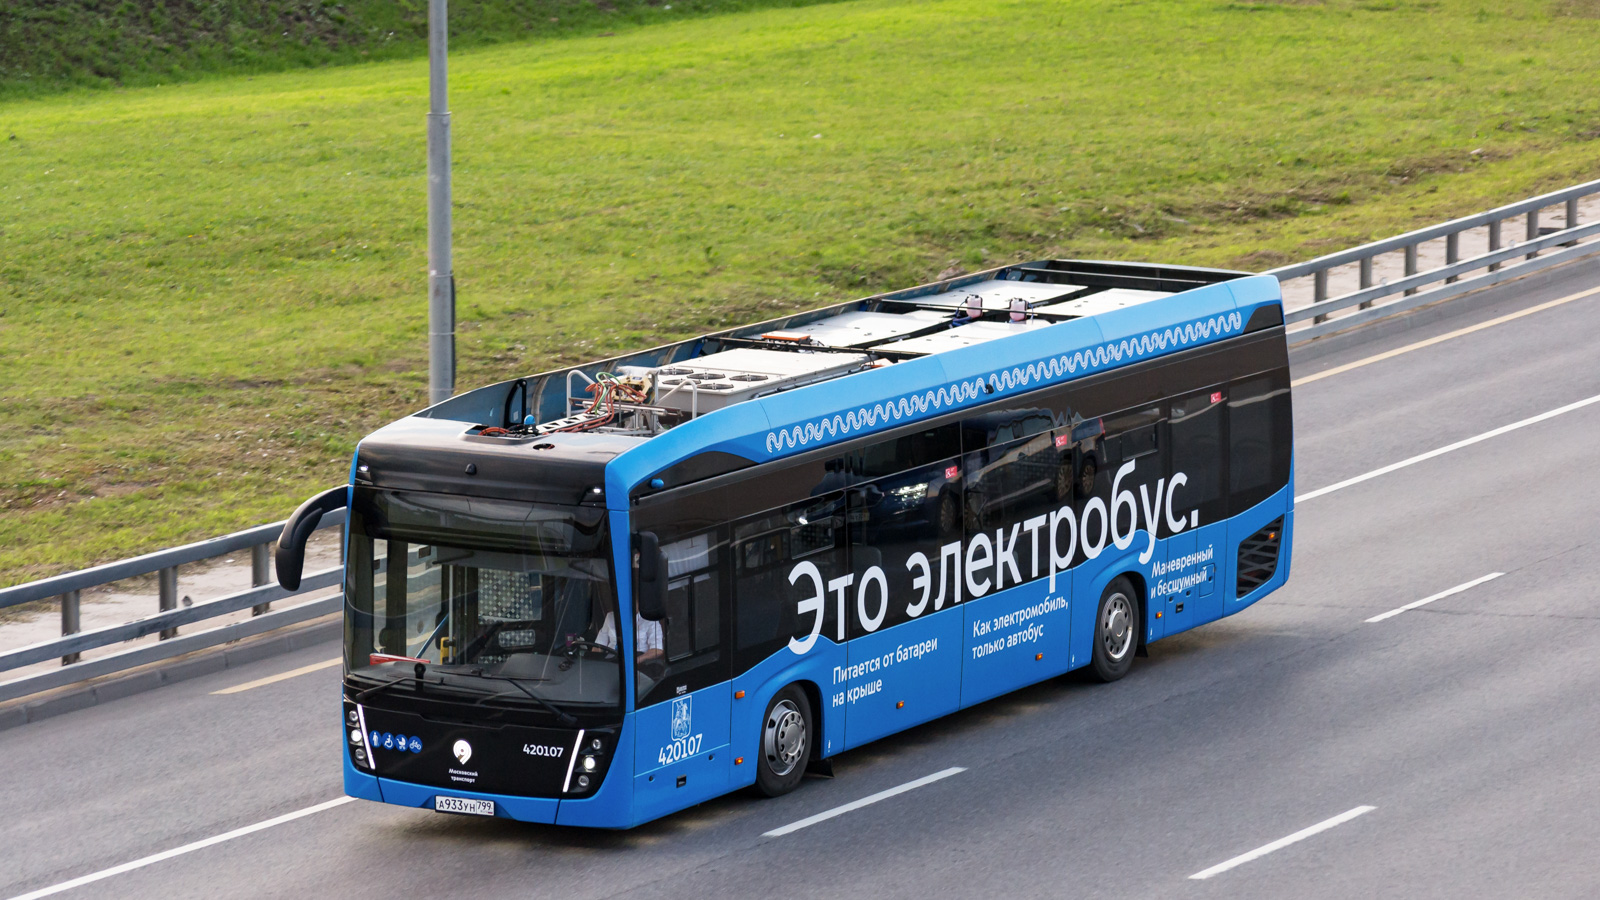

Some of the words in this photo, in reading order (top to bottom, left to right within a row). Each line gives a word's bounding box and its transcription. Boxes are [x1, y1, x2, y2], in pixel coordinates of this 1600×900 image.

[788, 560, 888, 655] Это
[905, 458, 1199, 618] электробус.
[1151, 544, 1213, 579] Маневренный
[1150, 586, 1156, 600] и
[1157, 566, 1207, 596] бесшумный
[973, 619, 991, 638] Как
[993, 595, 1069, 631] электромобиль,
[972, 637, 1005, 660] только
[1006, 622, 1044, 648] автобус
[833, 657, 880, 685] Питается
[882, 652, 895, 668] от
[896, 637, 938, 663] батареи
[832, 691, 845, 708] на
[846, 678, 883, 705] крыше
[522, 743, 564, 758] 420107
[658, 733, 703, 766] 420107
[448, 768, 479, 777] Московский
[450, 775, 476, 784] транспорт
